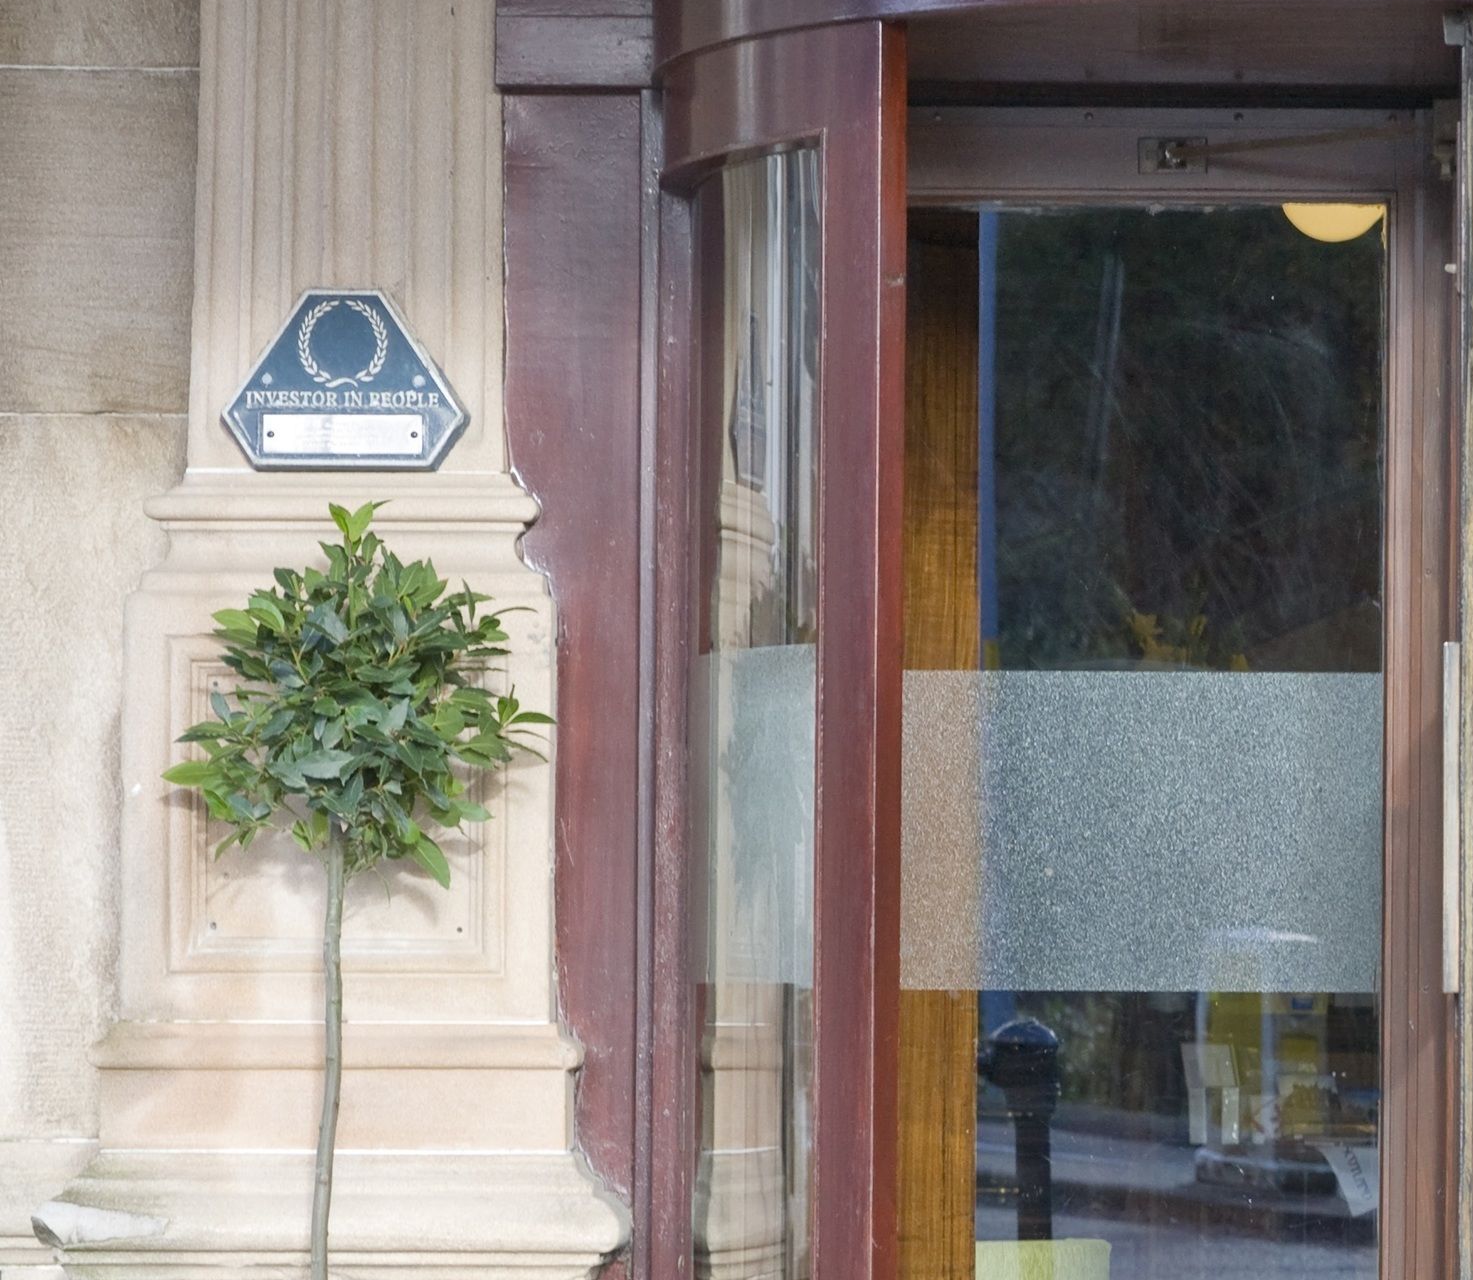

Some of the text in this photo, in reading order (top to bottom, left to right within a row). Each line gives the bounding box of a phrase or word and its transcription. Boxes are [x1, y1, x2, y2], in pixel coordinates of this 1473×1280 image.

[245, 390, 440, 408] INVESTOR IN PEOPLE
